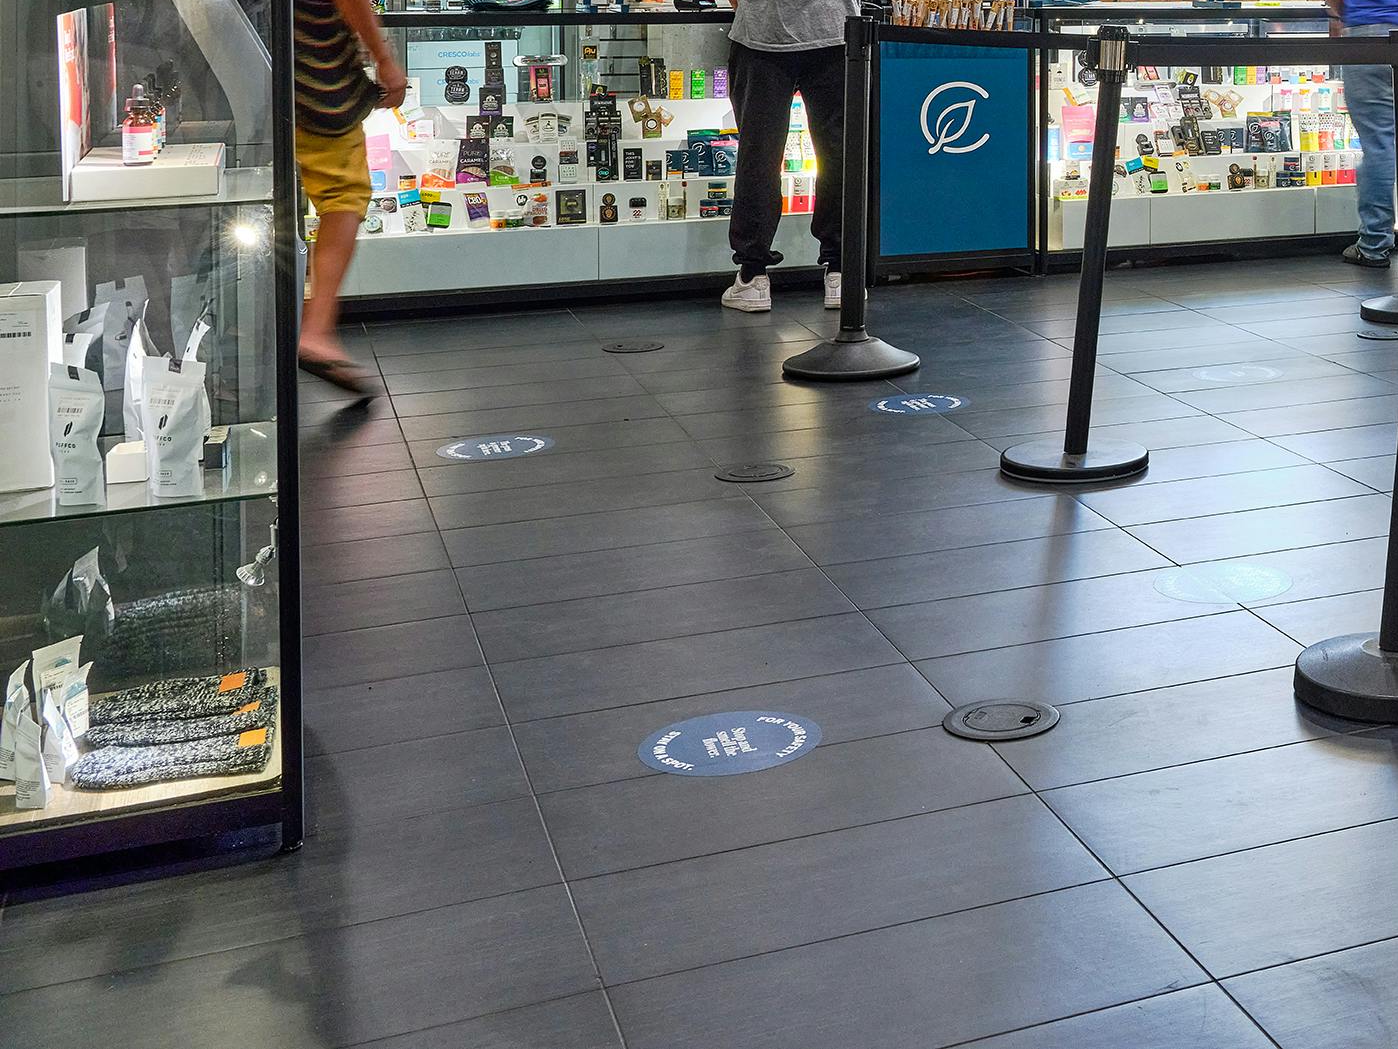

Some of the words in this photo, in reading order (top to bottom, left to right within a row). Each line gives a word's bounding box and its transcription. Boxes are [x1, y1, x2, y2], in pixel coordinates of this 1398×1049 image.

[632, 209, 642, 217] 22
[756, 716, 785, 725] FOR
[783, 721, 807, 735] YOUR
[657, 730, 681, 745] STAY
[776, 735, 807, 758] SAFETY
[661, 757, 695, 771] SPOT.
